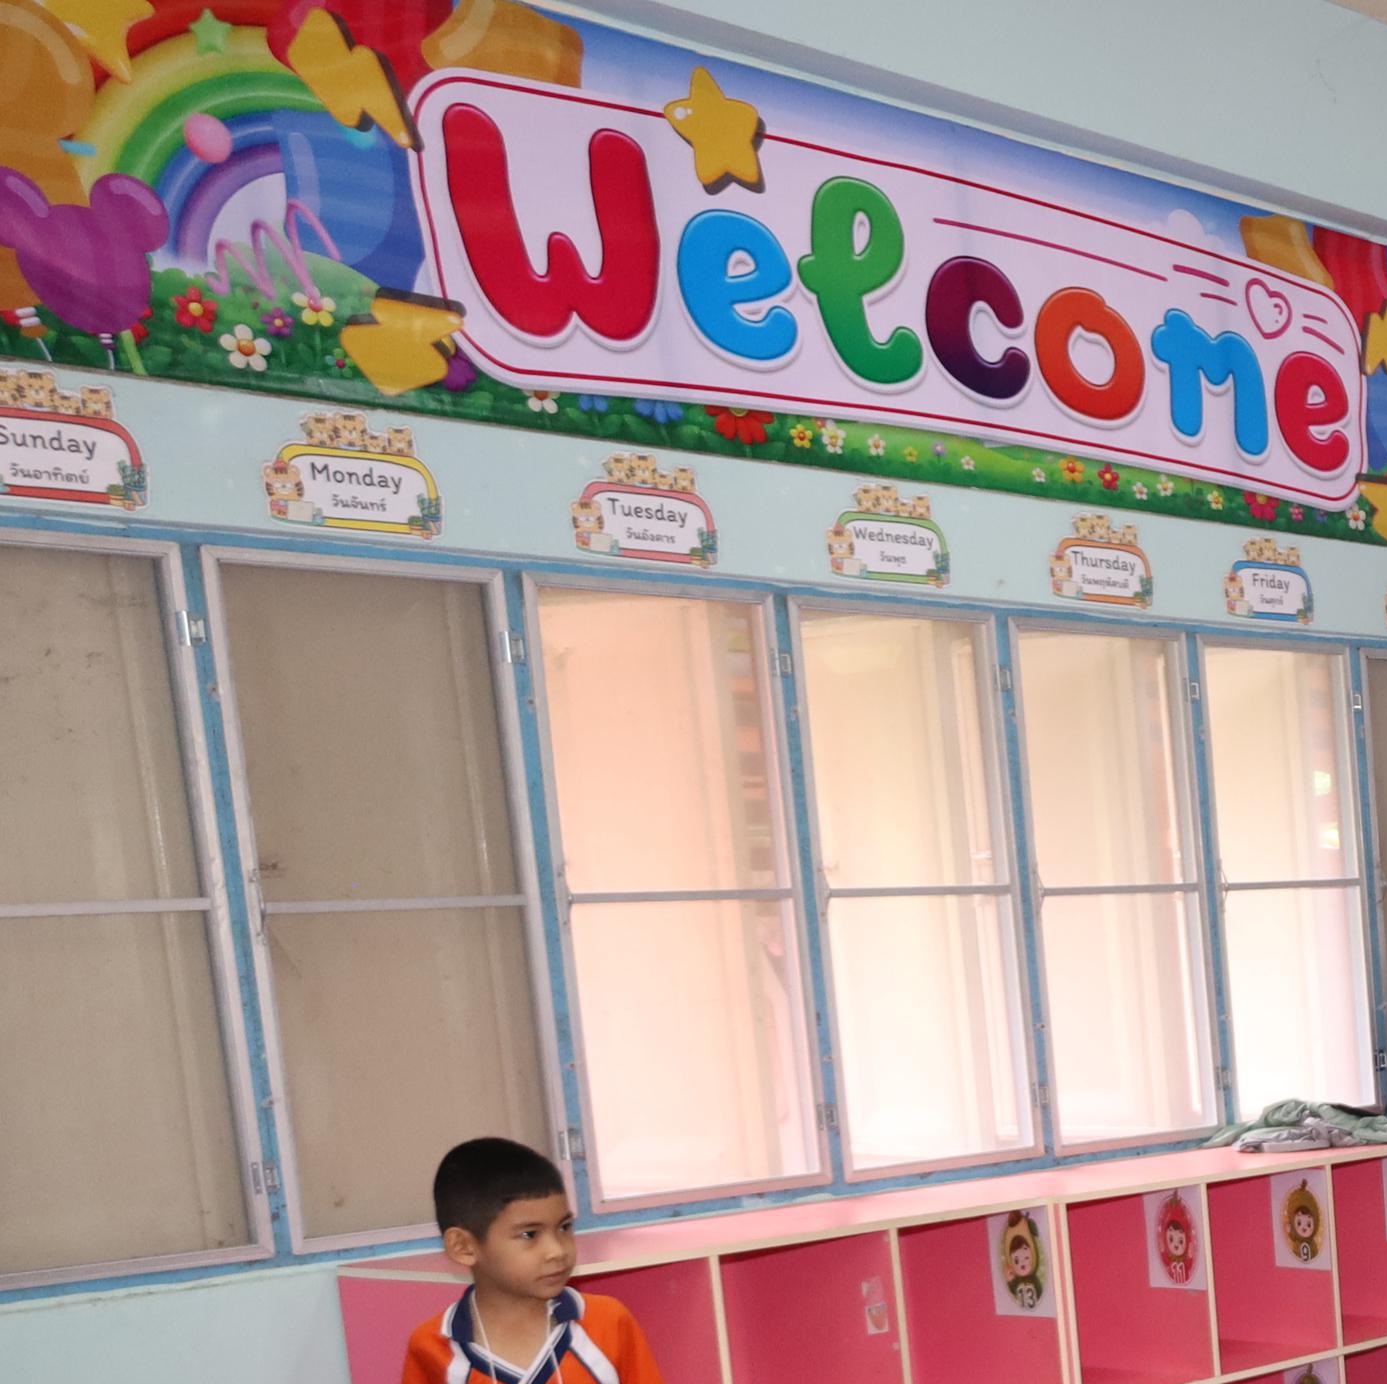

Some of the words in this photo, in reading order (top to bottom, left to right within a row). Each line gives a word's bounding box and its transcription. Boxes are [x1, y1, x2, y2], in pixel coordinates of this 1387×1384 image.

[440, 102, 1351, 473] Welcome
[0, 425, 97, 459] Sunday
[311, 461, 402, 493] Monday
[607, 497, 689, 528] Tuesday
[853, 526, 934, 550] Wednesday
[1071, 551, 1136, 577] Thursday
[1252, 573, 1290, 596] Friday
